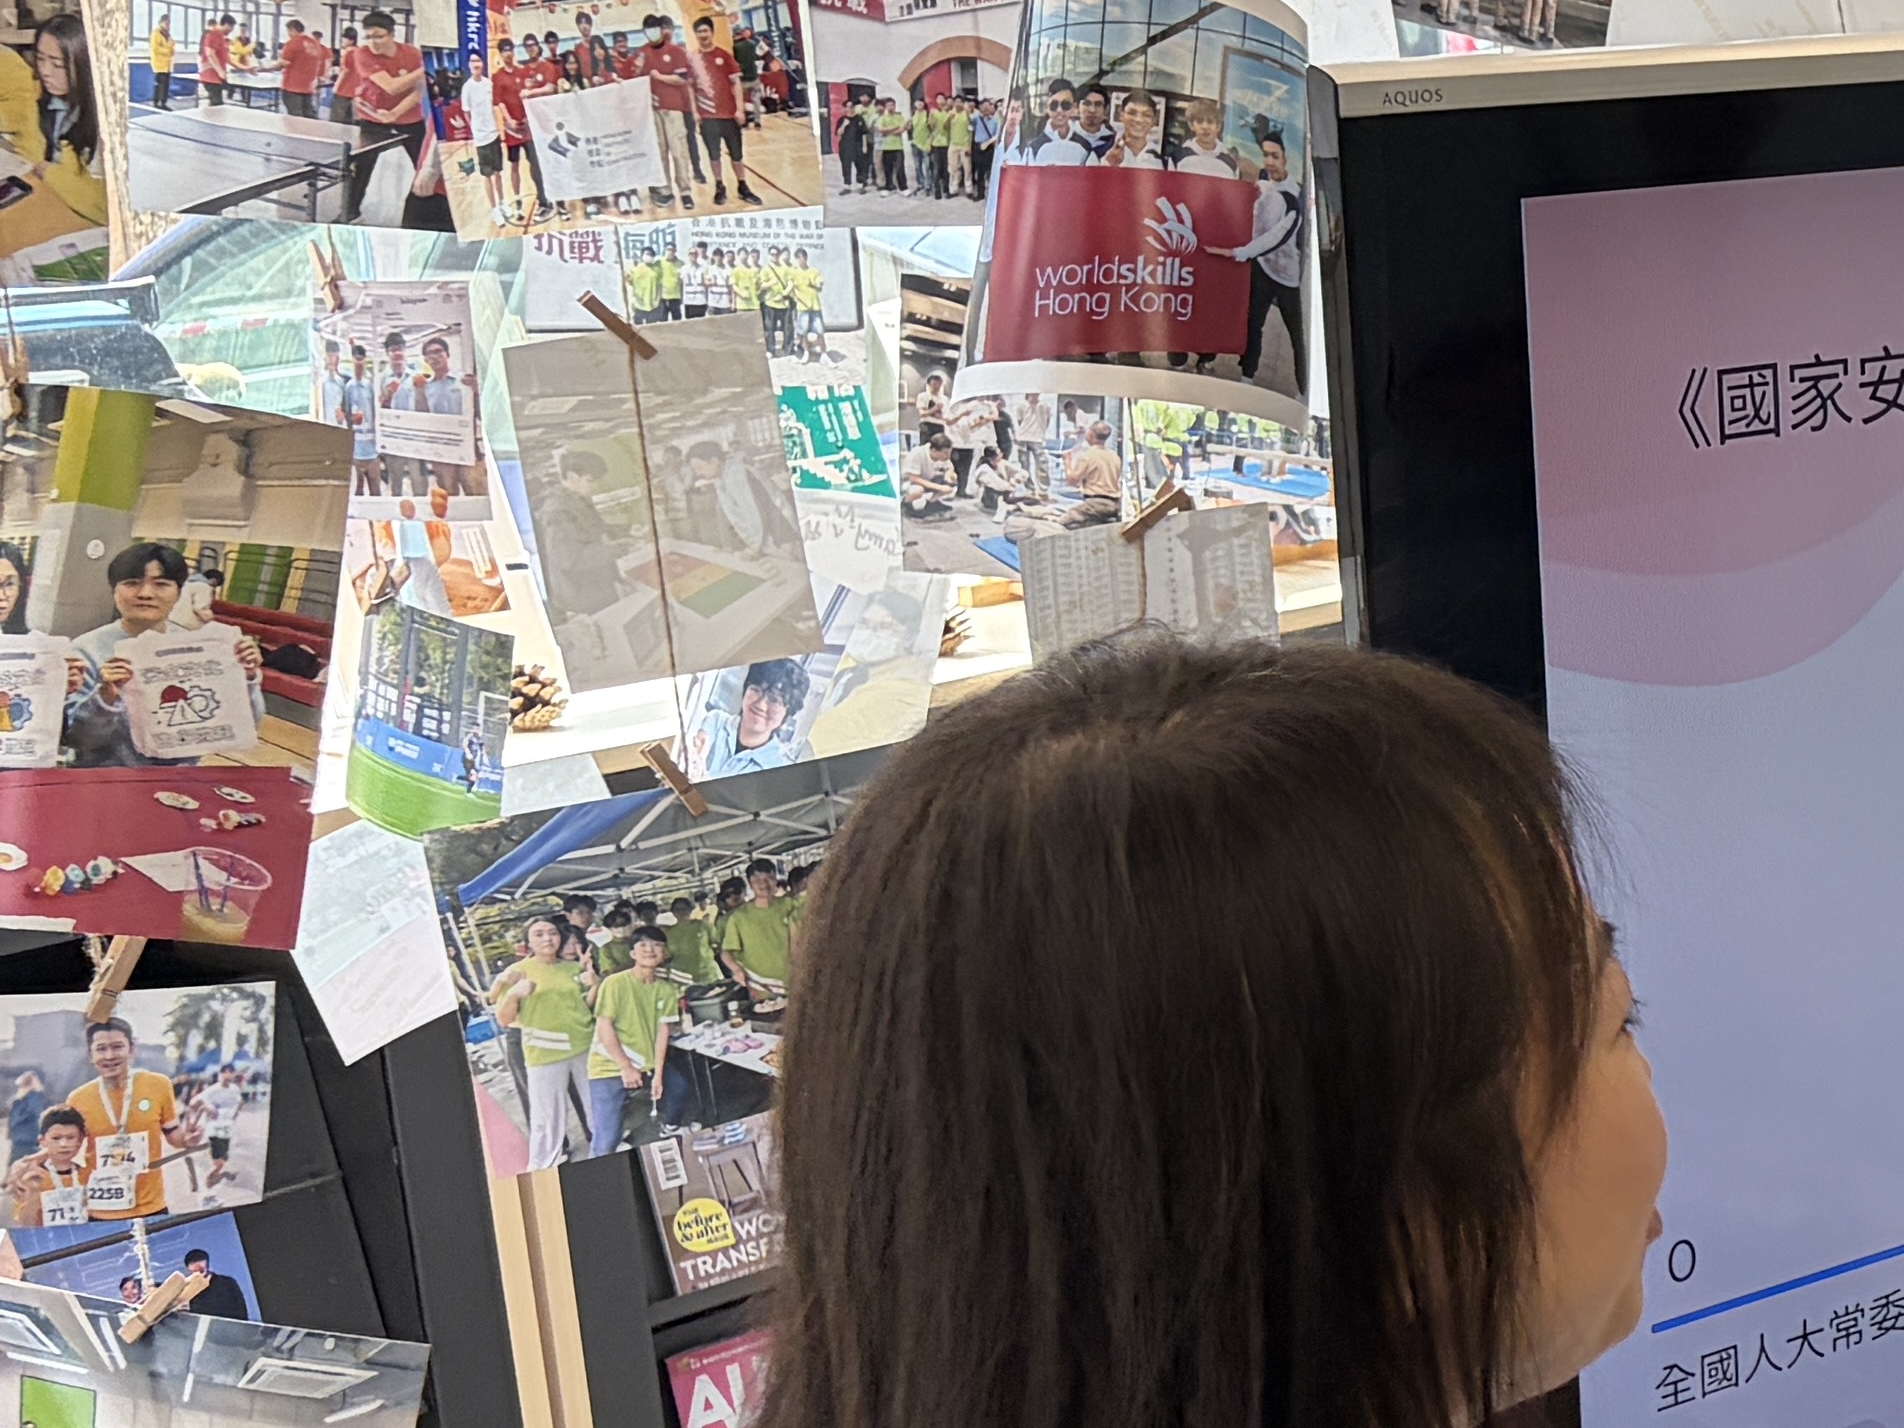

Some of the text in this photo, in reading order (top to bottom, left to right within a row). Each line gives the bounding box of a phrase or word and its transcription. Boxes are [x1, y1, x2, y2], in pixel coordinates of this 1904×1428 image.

[1383, 88, 1443, 107] AQUOS
[1035, 254, 1195, 287] worldskills
[1035, 286, 1193, 320] Hong Kong
[677, 1212, 723, 1233] before
[697, 1222, 730, 1240] after
[1668, 1239, 1697, 1282] 0
